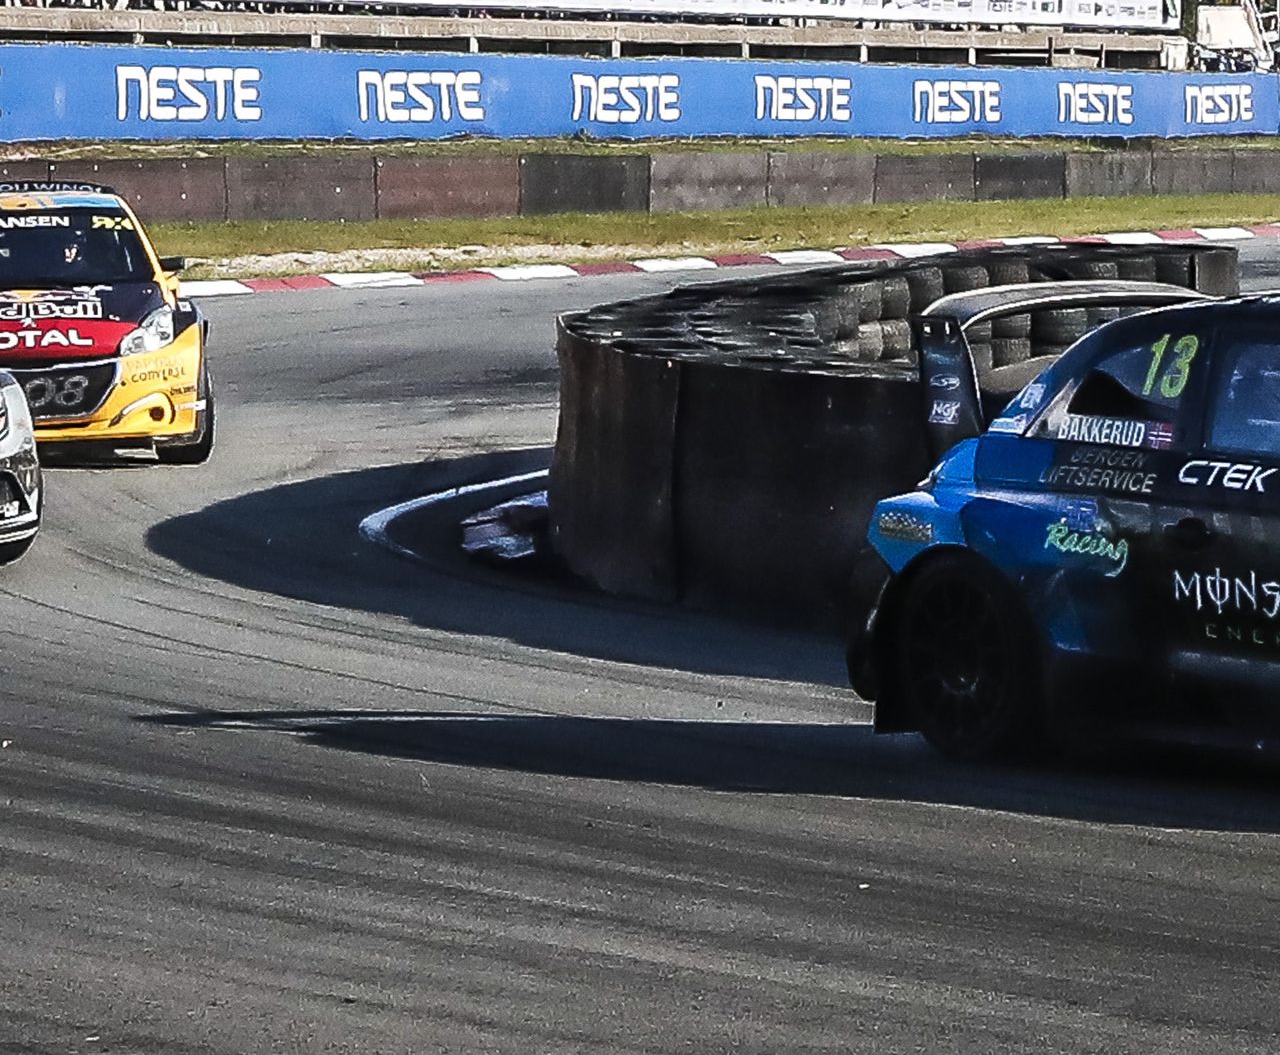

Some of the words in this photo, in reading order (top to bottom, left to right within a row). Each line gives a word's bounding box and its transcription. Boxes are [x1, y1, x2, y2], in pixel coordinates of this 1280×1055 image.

[116, 65, 262, 122] NESTE
[358, 70, 485, 123] NESTE
[571, 74, 681, 123] NESTE
[755, 75, 852, 122] NESTE
[913, 80, 1002, 124] NESTE
[1057, 82, 1135, 124] NESTE
[1184, 83, 1255, 124] NESTE
[28, 300, 102, 318] Bull
[1142, 334, 1199, 398] 13
[1058, 414, 1146, 446] BAKKERUD
[1038, 465, 1158, 493] LIFTSERVICE
[1070, 447, 1149, 468] BERGEN
[1178, 460, 1278, 492] CTEK
[1044, 521, 1128, 577] Racing
